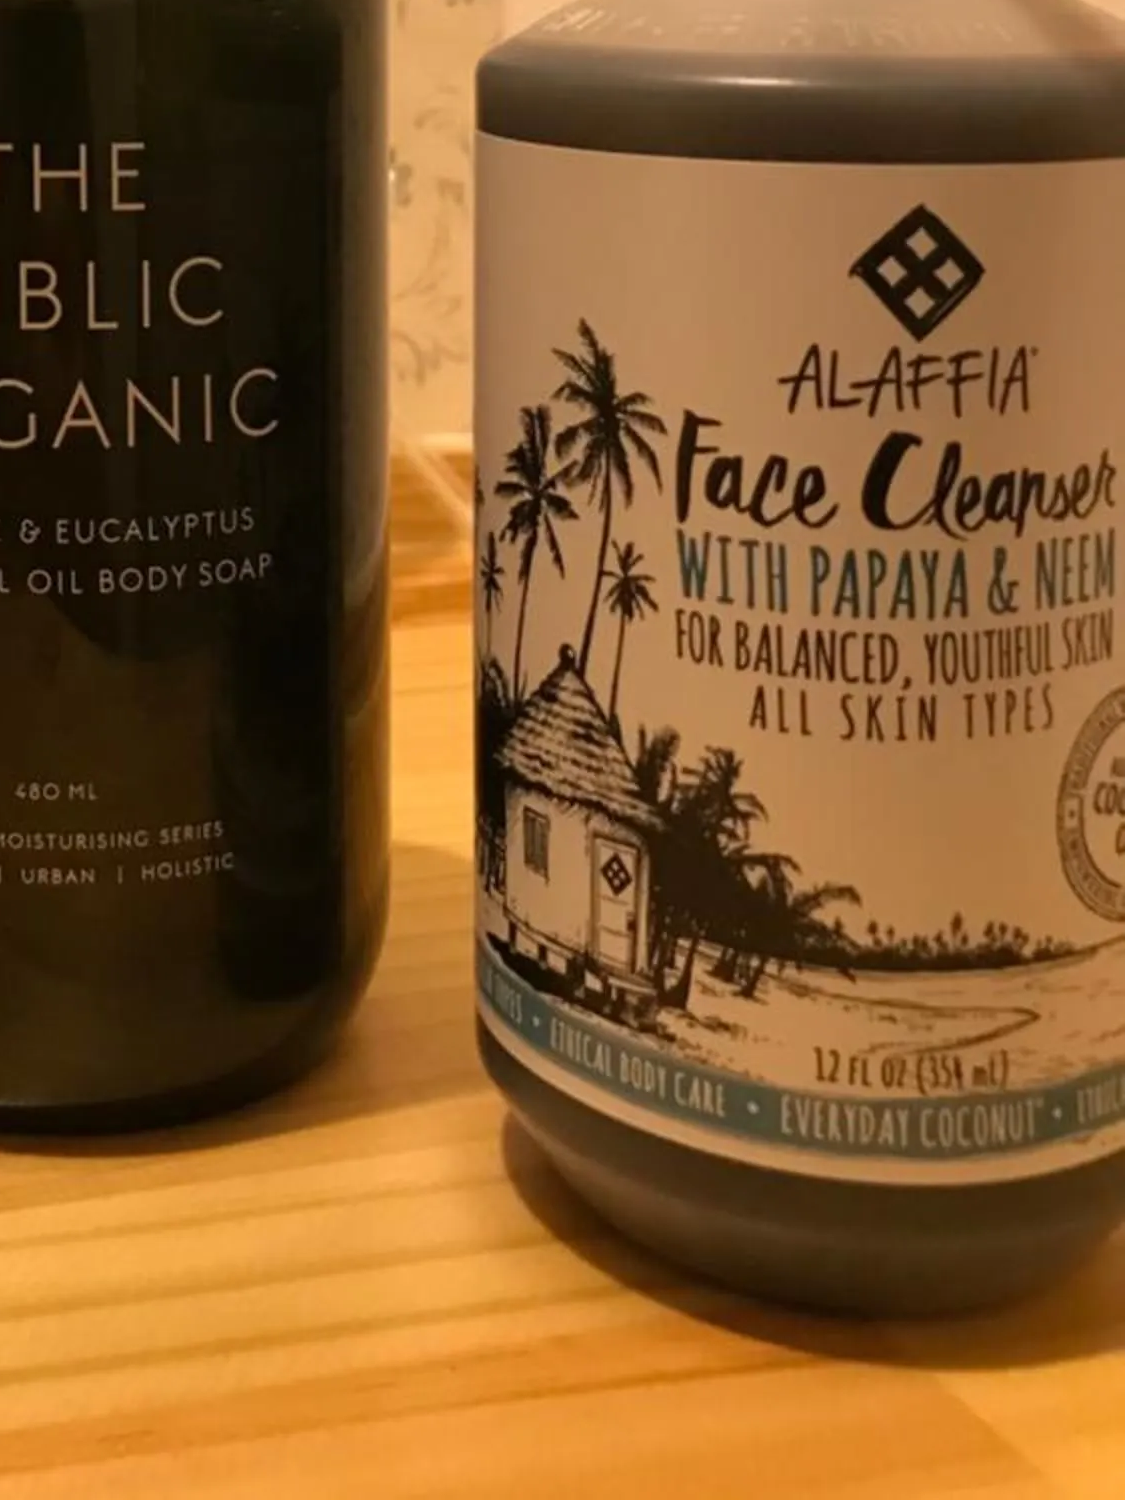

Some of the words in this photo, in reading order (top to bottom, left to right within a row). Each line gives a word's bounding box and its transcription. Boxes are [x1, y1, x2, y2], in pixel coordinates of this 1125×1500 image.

[676, 409, 840, 529] Face
[861, 431, 1117, 542] Cleanser
[19, 519, 41, 543] &
[55, 507, 255, 545] EUCALYPTUS
[27, 569, 83, 595] OIL
[98, 564, 188, 594] BODY
[199, 553, 273, 587] SOAP
[676, 528, 788, 615] WITH
[810, 545, 969, 621] PAPAYA
[987, 546, 1019, 615] &
[1035, 528, 1115, 611] NEEM
[675, 608, 723, 667] FOR
[735, 619, 912, 691] BALANCED,
[925, 620, 1054, 685] YOUTHFUL
[1061, 608, 1114, 671] SKIN
[749, 685, 813, 736] ALL
[841, 693, 937, 743] SKIN
[963, 683, 1054, 738] TYPES
[14, 783, 60, 801] 480
[69, 783, 98, 801] ML
[159, 820, 224, 845] SERIES
[20, 866, 96, 885] URBAN
[141, 851, 235, 882] HOLISTIC
[550, 1017, 612, 1077] ETHICAL
[620, 1051, 667, 1099] BODY
[675, 1071, 725, 1118] CARE
[780, 1108, 909, 1148] EVERYDAY
[814, 1046, 841, 1084] 12
[848, 1055, 872, 1088] FL
[881, 1056, 906, 1089] OZ
